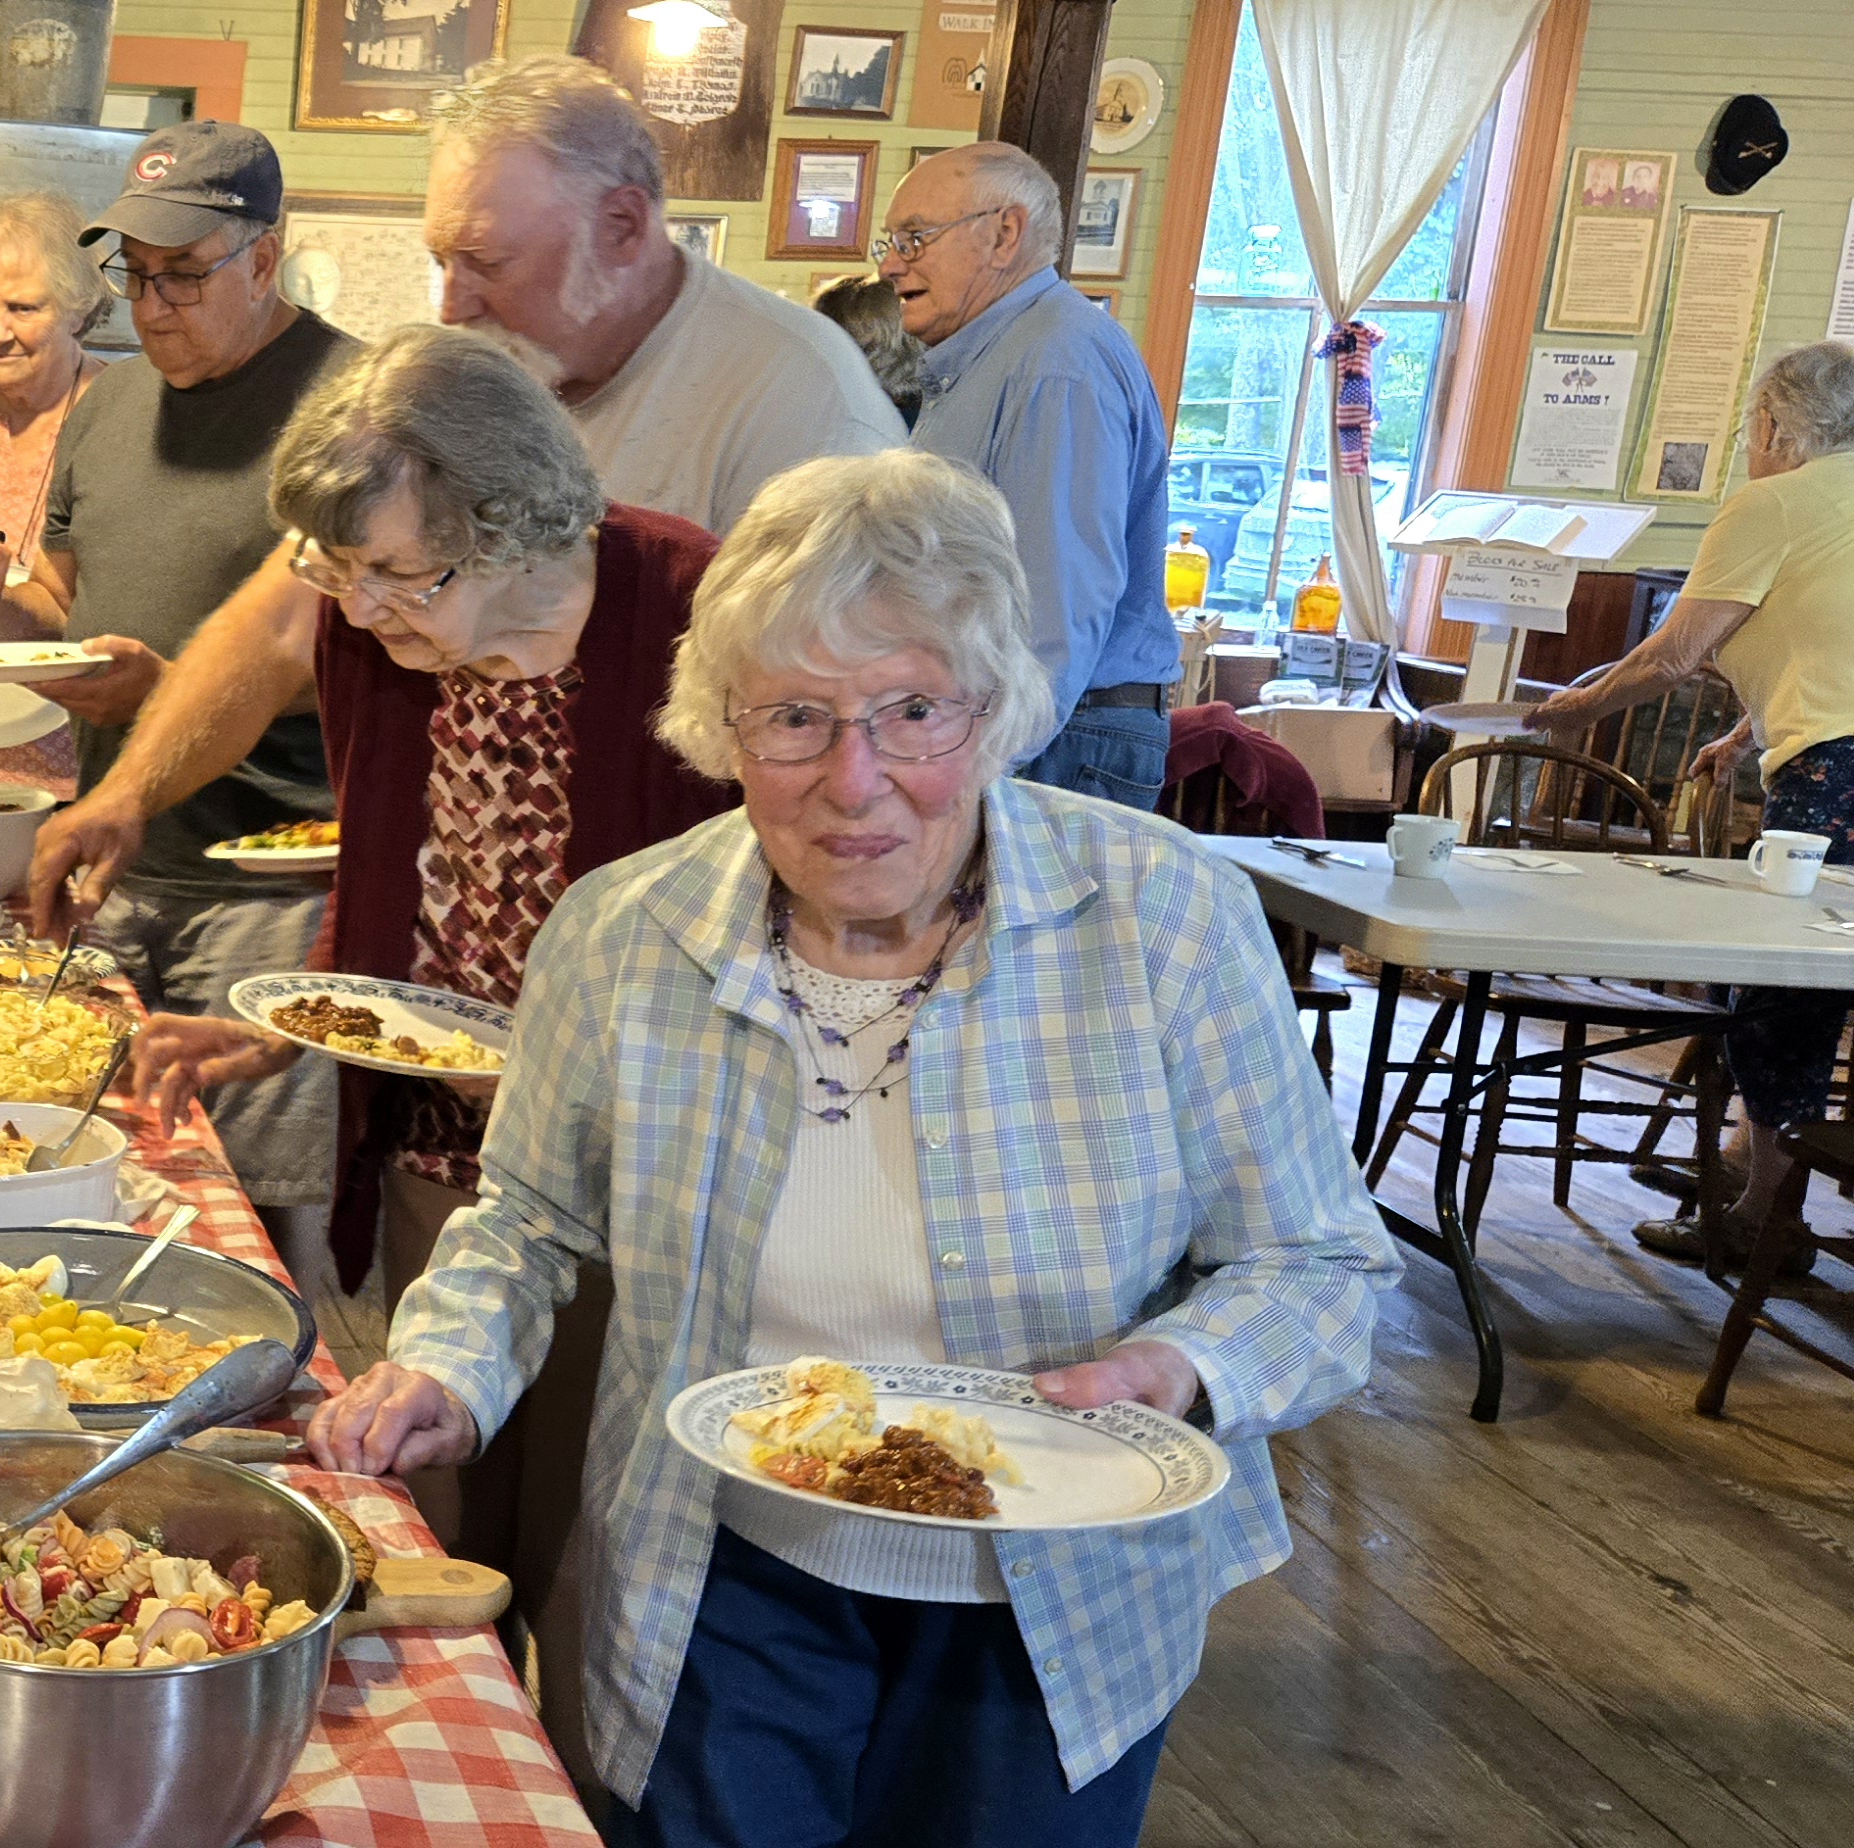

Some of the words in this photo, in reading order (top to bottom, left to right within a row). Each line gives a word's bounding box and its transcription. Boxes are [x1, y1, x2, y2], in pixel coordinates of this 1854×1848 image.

[942, 15, 978, 29] WALK
[135, 151, 177, 182] C
[1553, 354, 1580, 365] THE
[1581, 355, 1615, 366] CALL
[1543, 393, 1560, 404] TO
[1562, 394, 1602, 406] ARMS
